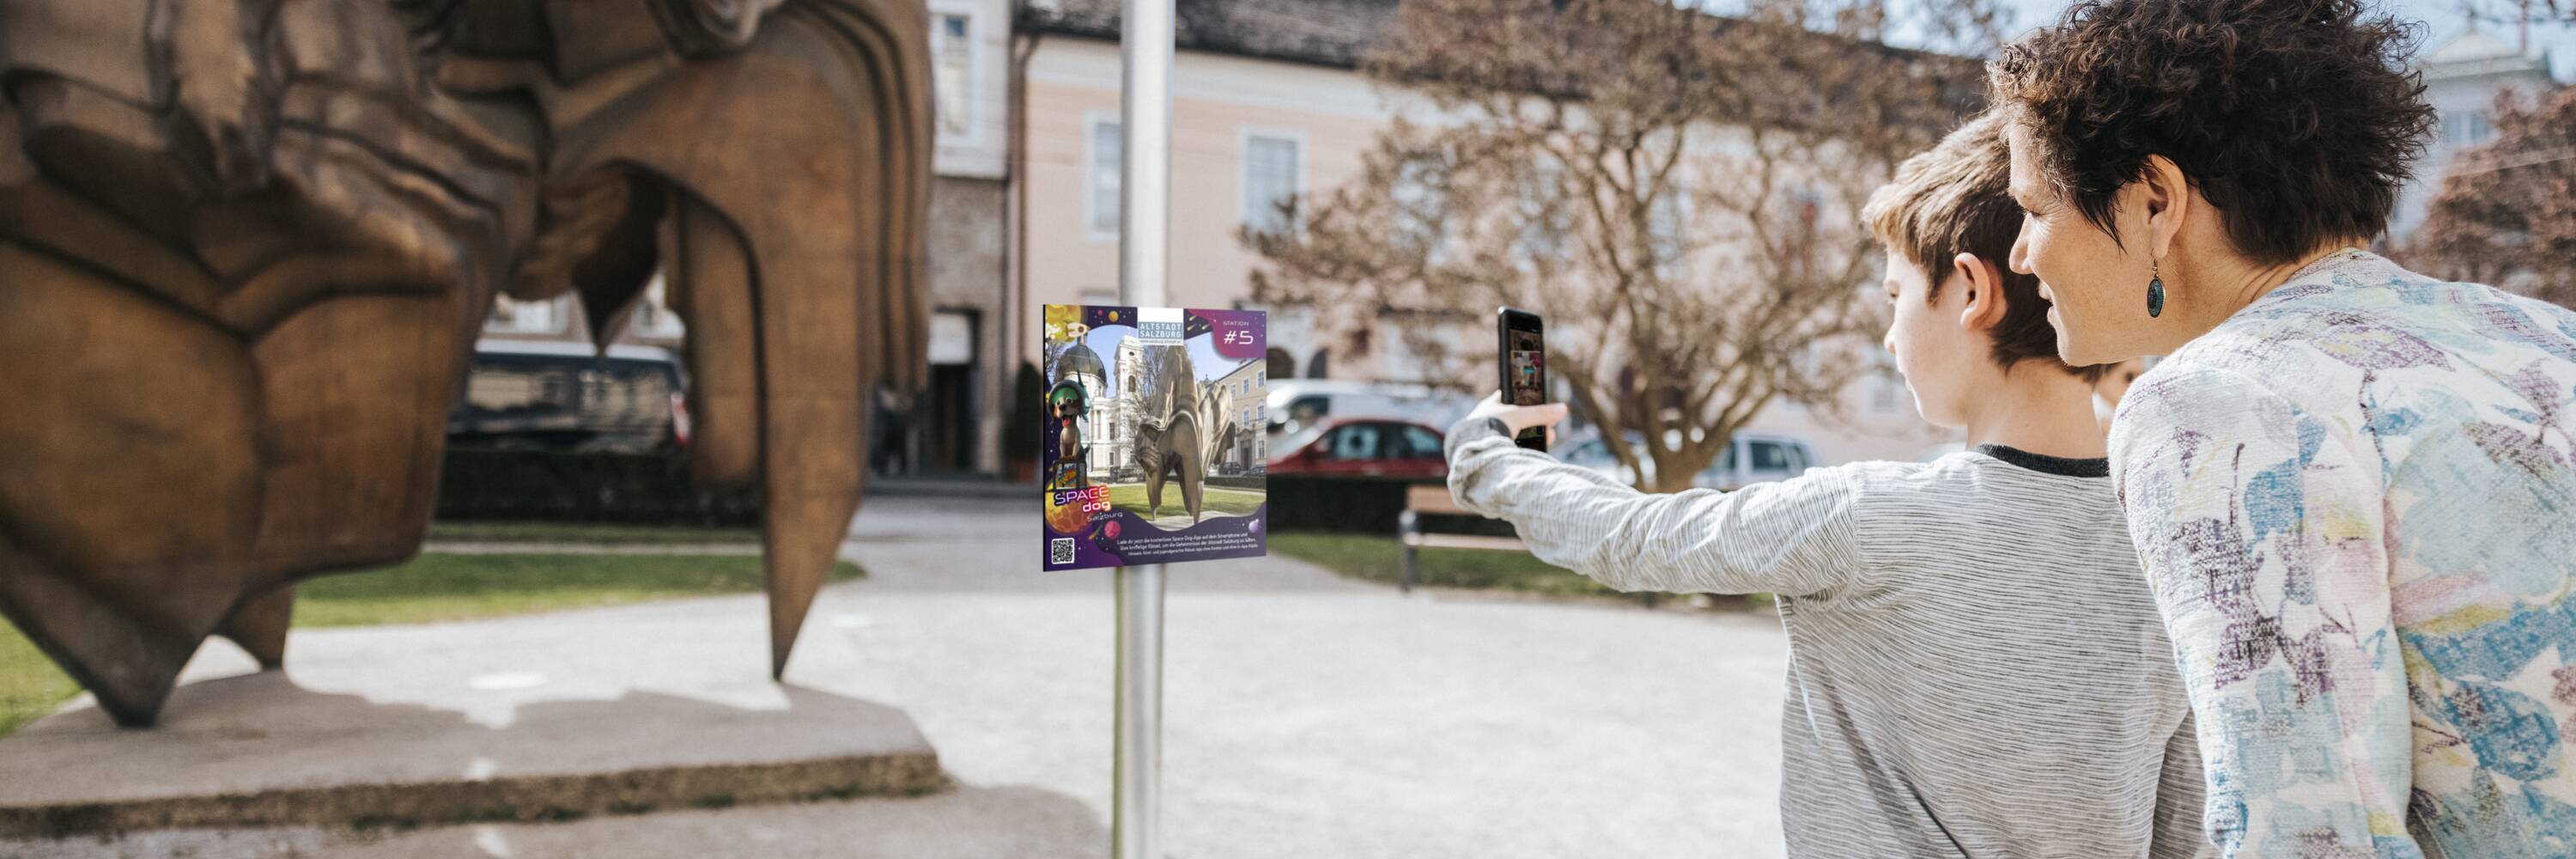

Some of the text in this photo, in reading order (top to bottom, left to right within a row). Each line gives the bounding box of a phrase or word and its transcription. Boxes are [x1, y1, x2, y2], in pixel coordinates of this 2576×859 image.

[1223, 331, 1254, 344] #5
[1054, 486, 1109, 505] SPACE
[1082, 501, 1111, 512] dog
[1086, 512, 1123, 521] Salzburg
